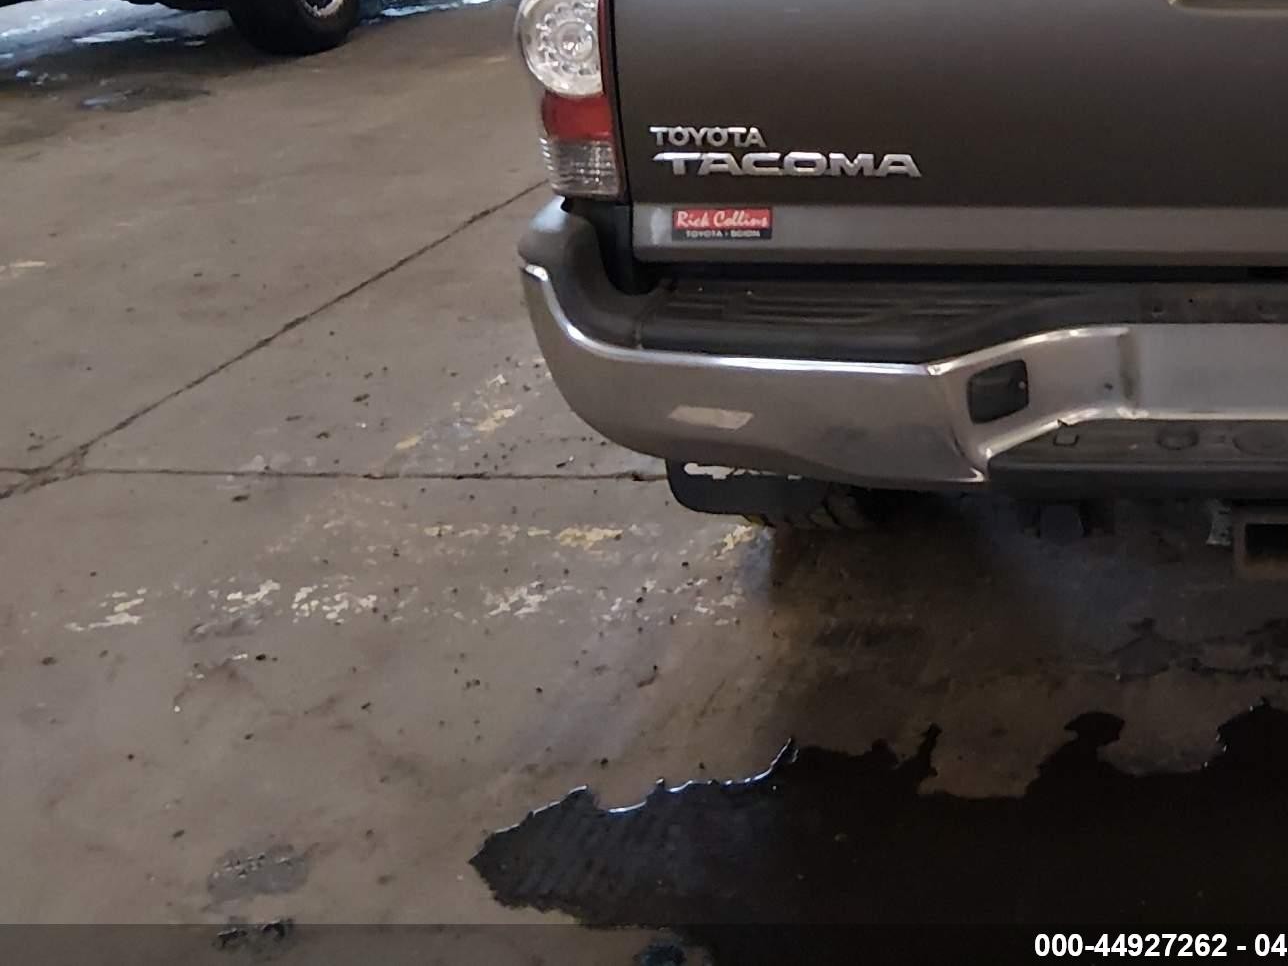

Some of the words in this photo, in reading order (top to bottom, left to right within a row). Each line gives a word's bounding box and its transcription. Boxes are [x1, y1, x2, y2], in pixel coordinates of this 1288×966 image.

[650, 126, 767, 148] TOYOTA
[653, 151, 922, 178] TACOMA
[677, 210, 710, 228] Rick
[713, 209, 769, 228] Collins
